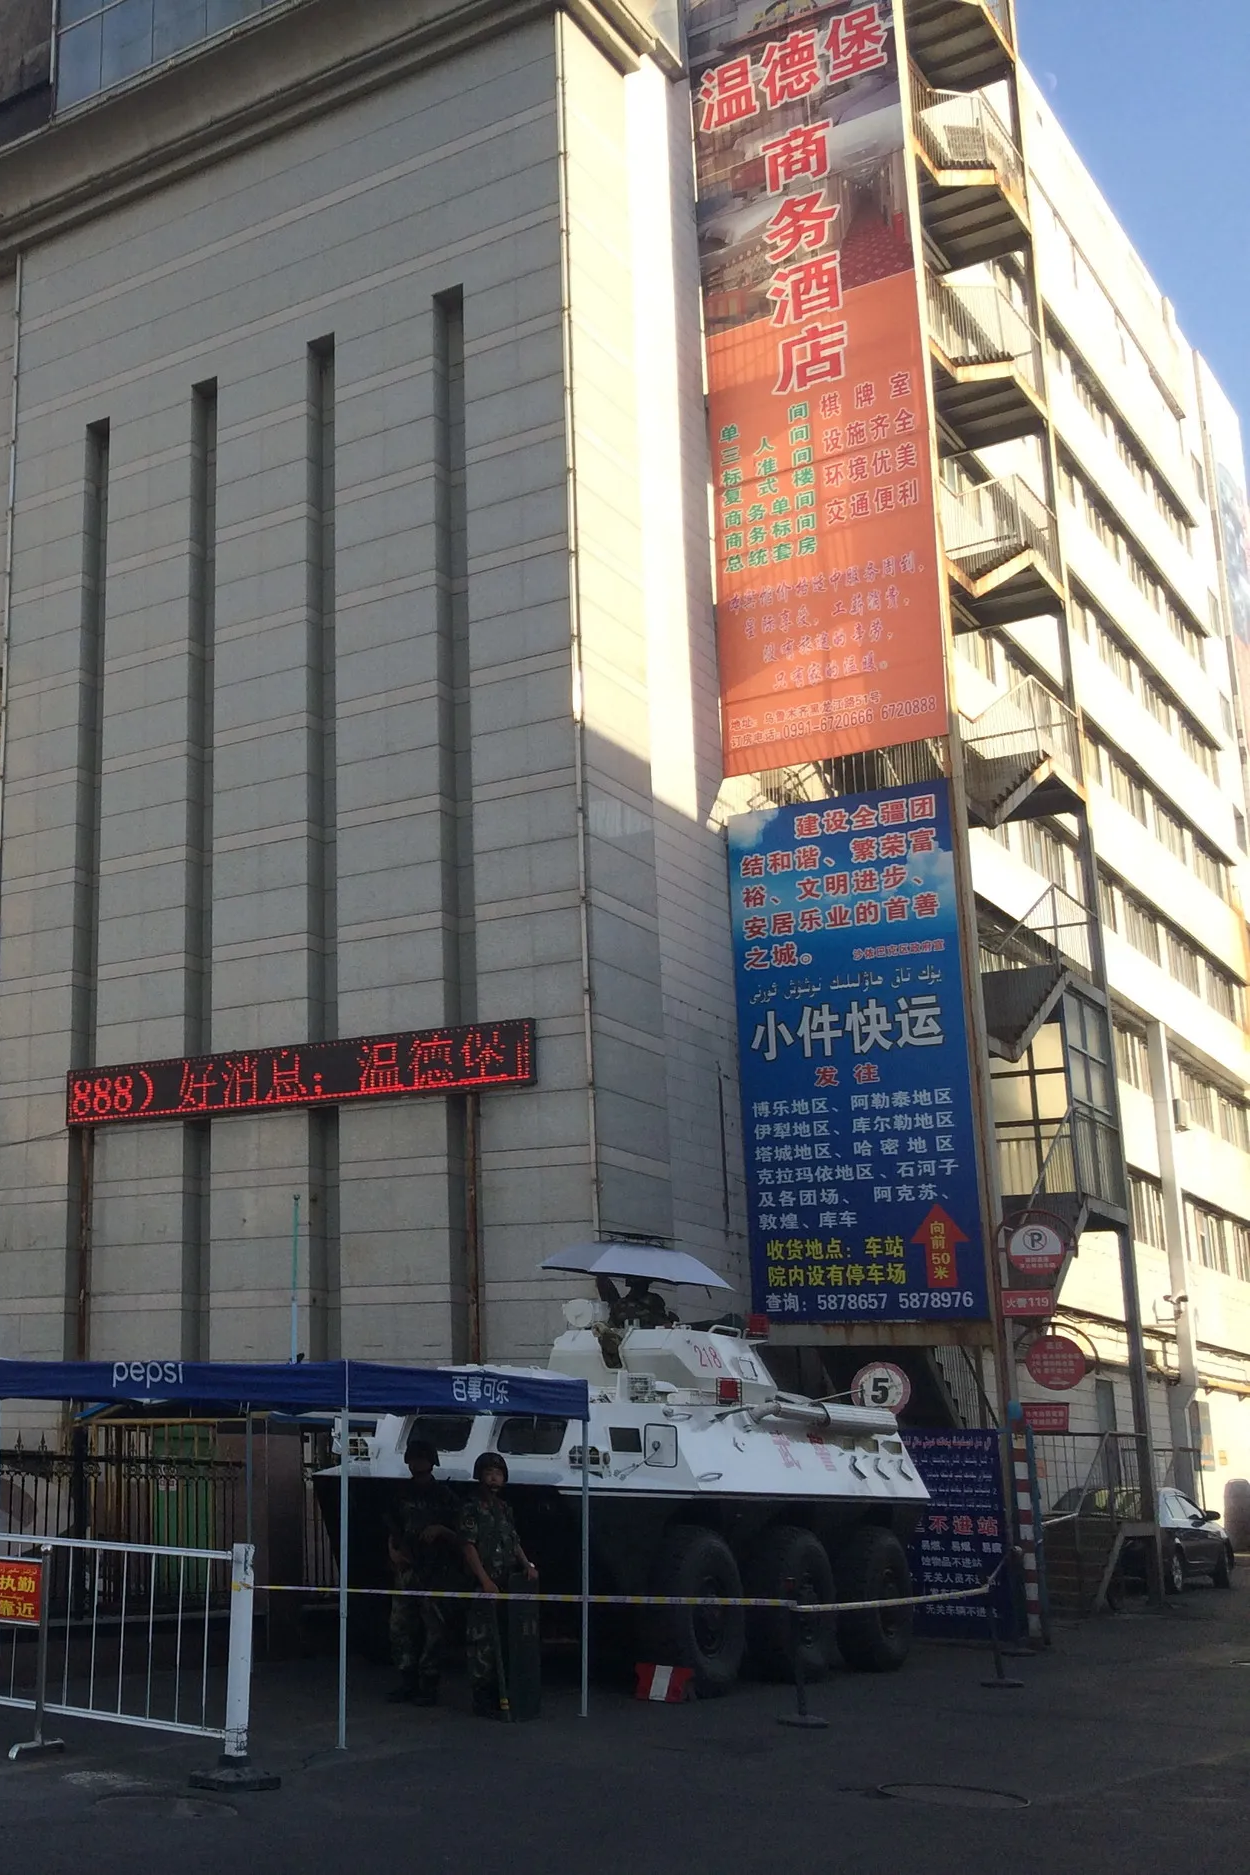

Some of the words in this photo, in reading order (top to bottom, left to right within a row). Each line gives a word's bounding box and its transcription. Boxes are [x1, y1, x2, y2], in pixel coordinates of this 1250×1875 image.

[699, 4, 889, 133] 温德堡
[761, 117, 848, 395] 商务酒店
[820, 371, 913, 419] 棋牌室
[822, 407, 917, 454] 设施齐全
[823, 442, 918, 489] 环境优美
[724, 490, 815, 529] 商务单间
[825, 479, 919, 526] 交通便利
[725, 513, 817, 551] 商务标间
[725, 535, 818, 573] 总统套房
[881, 696, 937, 720] 6720888
[795, 794, 936, 839] 建设全疆团
[741, 828, 936, 878] 结和谐、繁荣富
[742, 865, 924, 910] 裕、文明进步、
[744, 893, 939, 940] 安居乐业的首善
[744, 943, 813, 971] 之城。
[751, 995, 945, 1060] 小件快运
[814, 1063, 880, 1088] 发往
[752, 1087, 953, 1119] 博乐地区、阿勒泰地区
[754, 1111, 955, 1140] 伊犁地区、库尔勒地区
[754, 1135, 955, 1163] 塔城地区、哈密地区
[756, 1158, 959, 1186] 克拉玛依地区、石河子
[759, 1211, 858, 1231] 敦煌、库车
[766, 1235, 904, 1261] 收货地点：车站
[767, 1263, 906, 1288] 院内设有停车场
[898, 1291, 975, 1309] 5878976
[694, 1345, 722, 1369] 218
[112, 1360, 184, 1388] pepsi
[451, 1376, 510, 1405] 百事可乐
[871, 1377, 890, 1404] 5
